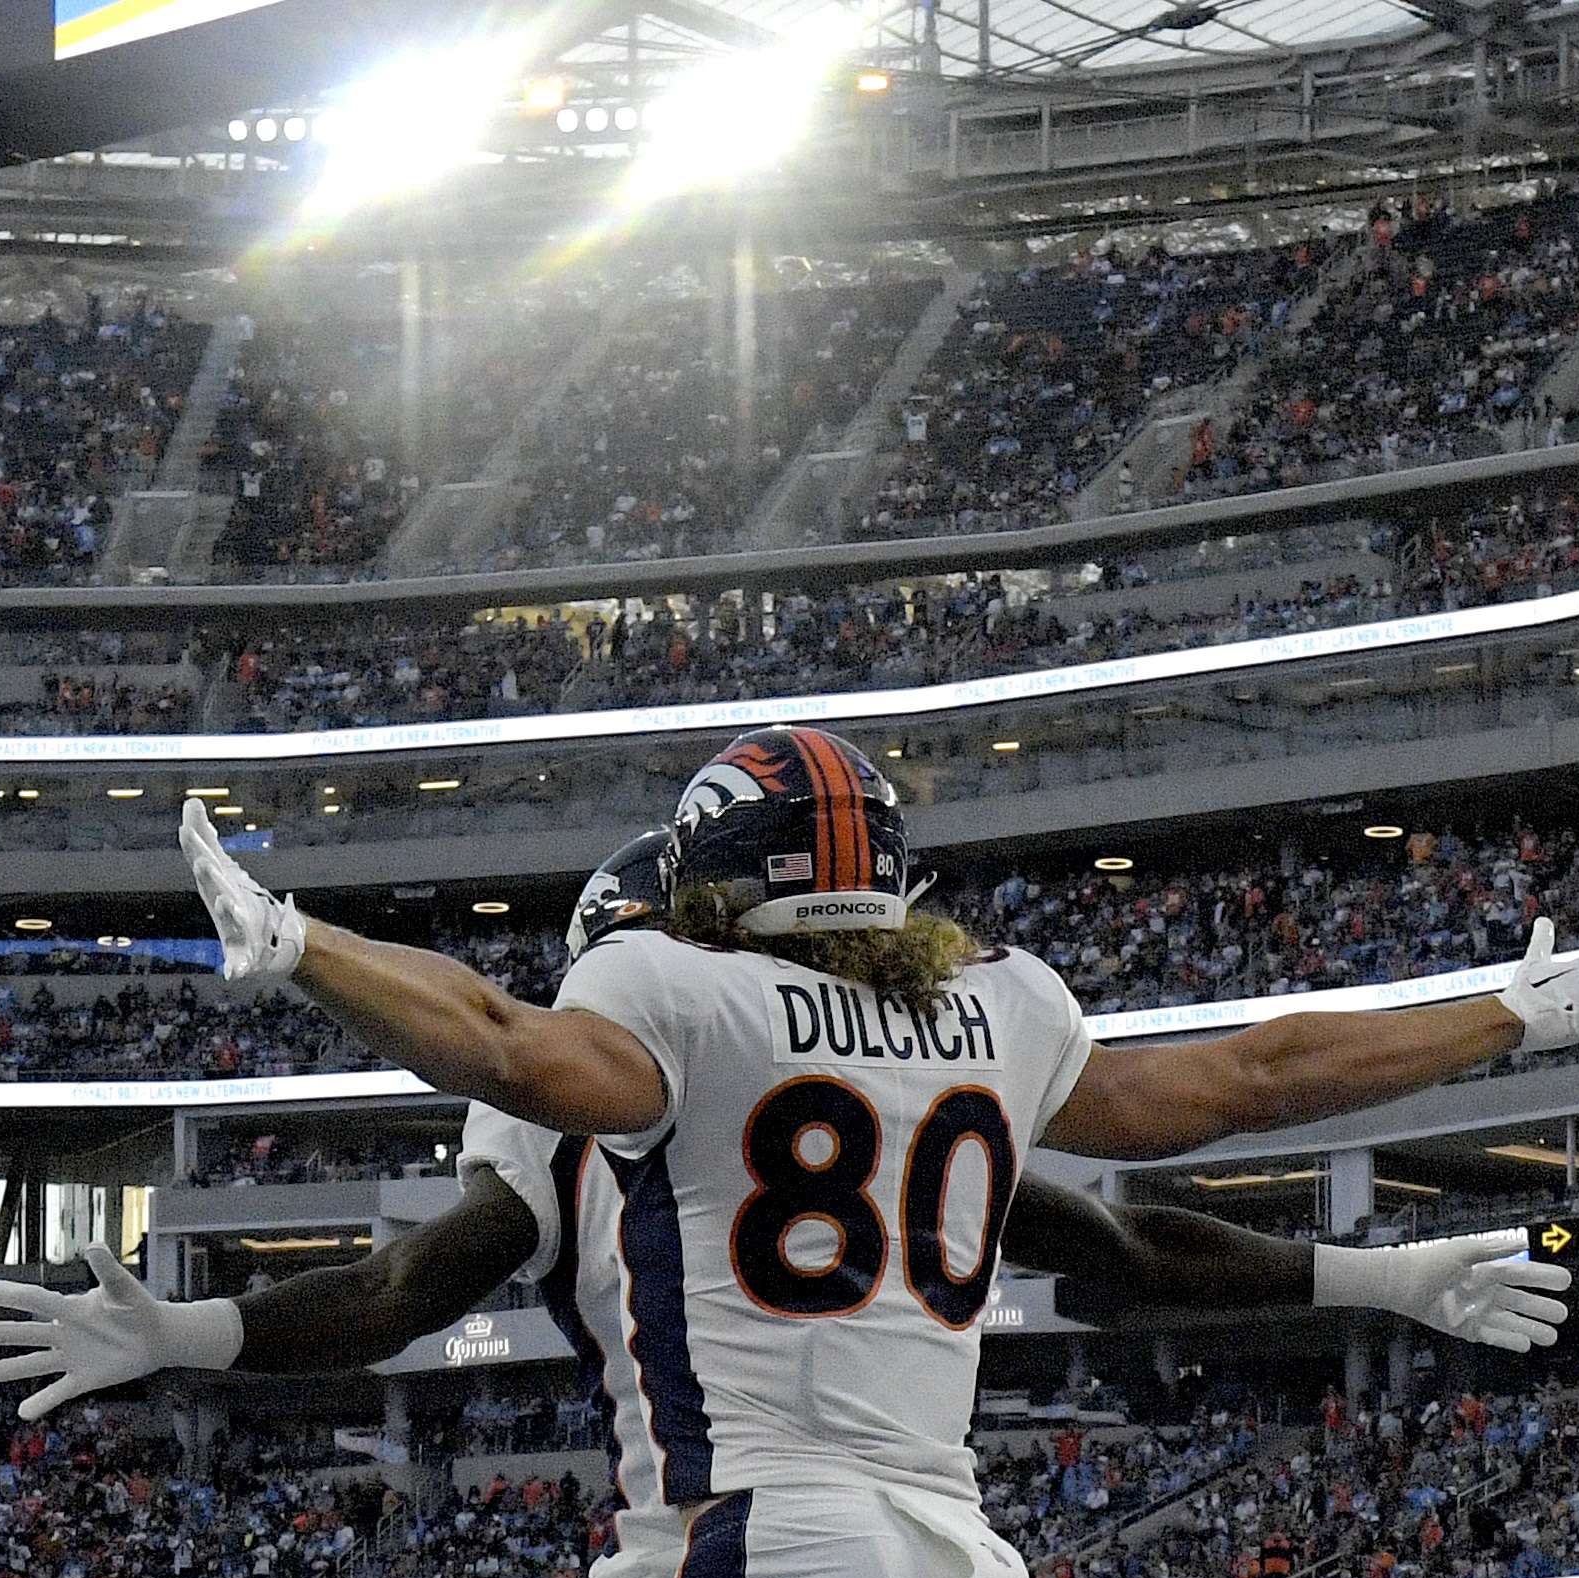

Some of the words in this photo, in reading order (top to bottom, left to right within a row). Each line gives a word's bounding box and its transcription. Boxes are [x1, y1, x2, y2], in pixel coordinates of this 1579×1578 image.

[876, 853, 894, 877] 80
[796, 902, 887, 918] BRONCOS
[776, 981, 995, 1061] DULCICH
[175, 1085, 200, 1097] NEW
[204, 1082, 272, 1096] ALTERNATIVE
[728, 1073, 1018, 1332] 80
[443, 1336, 511, 1367] Corona
